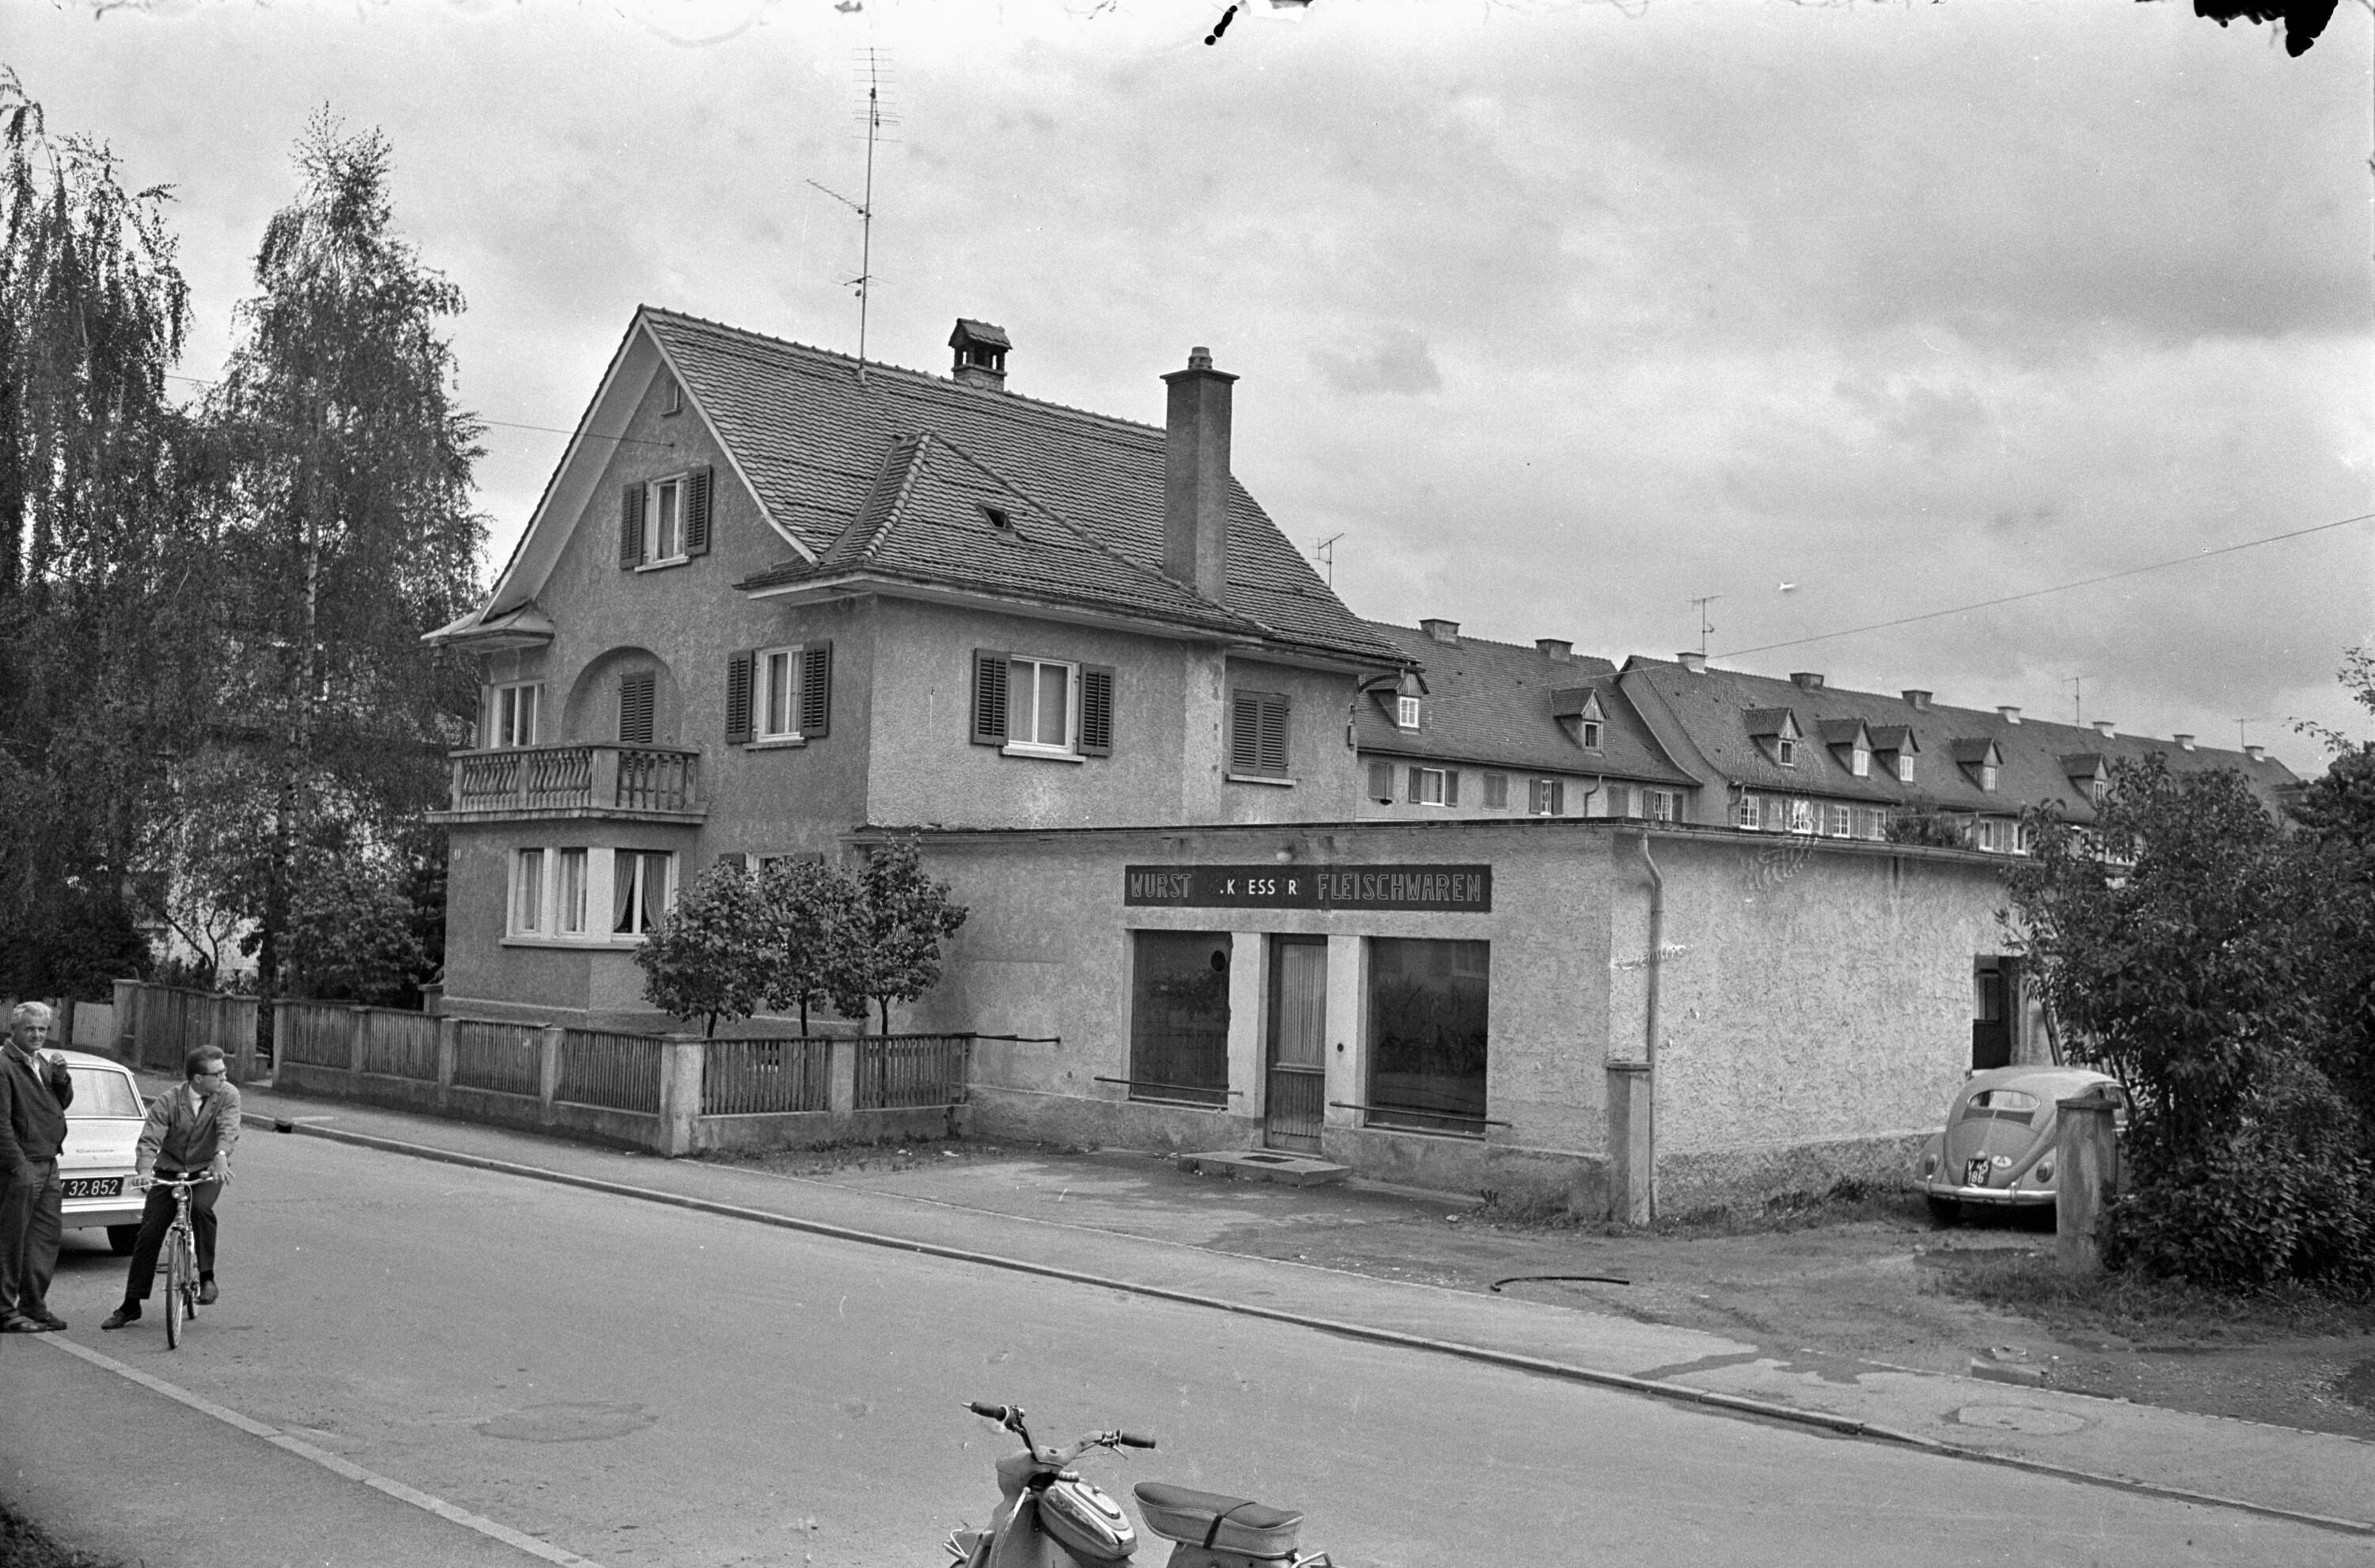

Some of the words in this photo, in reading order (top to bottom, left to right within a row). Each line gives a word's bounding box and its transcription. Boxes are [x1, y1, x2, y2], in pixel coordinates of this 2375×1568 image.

[1130, 873, 1191, 898] WURST
[1317, 874, 1480, 902] FLEISCHWAREN
[68, 1179, 119, 1197] 32.852
